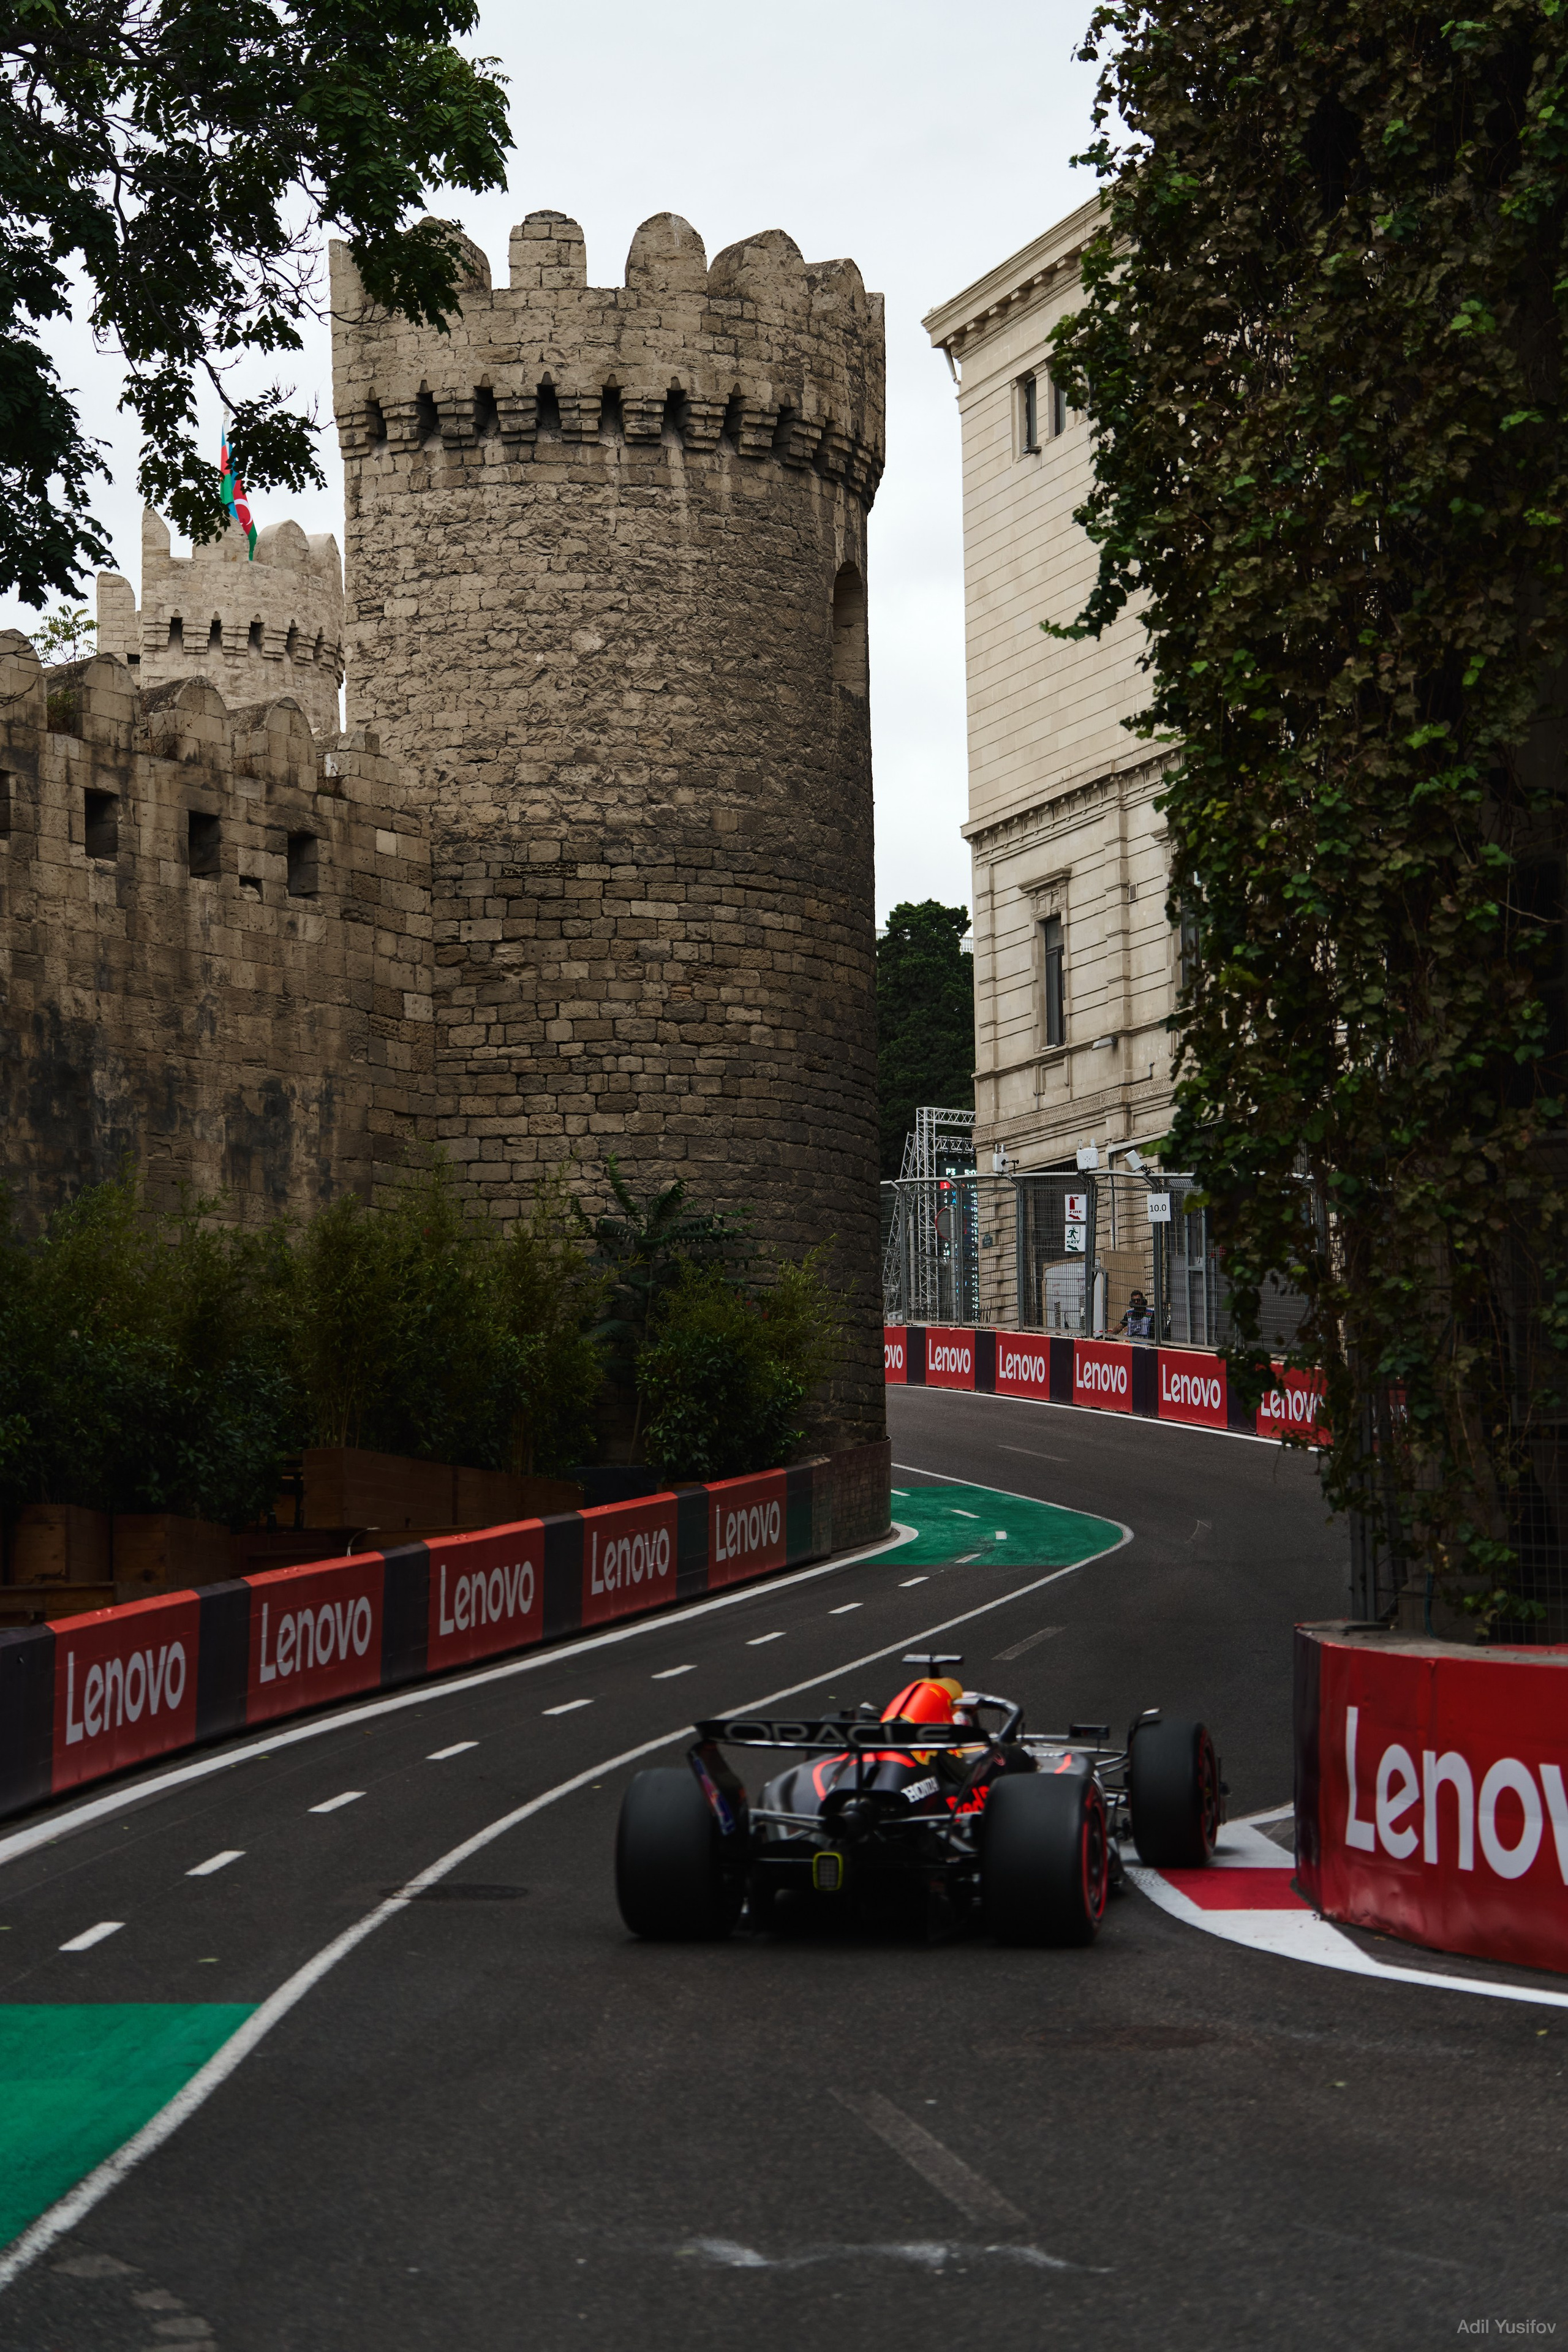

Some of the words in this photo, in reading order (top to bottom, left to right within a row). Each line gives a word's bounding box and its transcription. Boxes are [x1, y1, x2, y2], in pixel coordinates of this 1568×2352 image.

[884, 1344, 903, 1369] ovo
[929, 1339, 971, 1374] Lenovo
[999, 1345, 1046, 1383] Lenovo
[1076, 1353, 1127, 1394] Lenovo
[1162, 1364, 1221, 1409] Lenovo
[715, 1501, 780, 1562] Lenovo
[591, 1528, 670, 1596] Lenovo
[439, 1561, 534, 1636] Lenovo
[260, 1596, 372, 1683] Lenovo
[66, 1642, 186, 1745] Lenovo
[724, 1722, 951, 1744] ORACLE
[900, 1776, 940, 1803] HONDA
